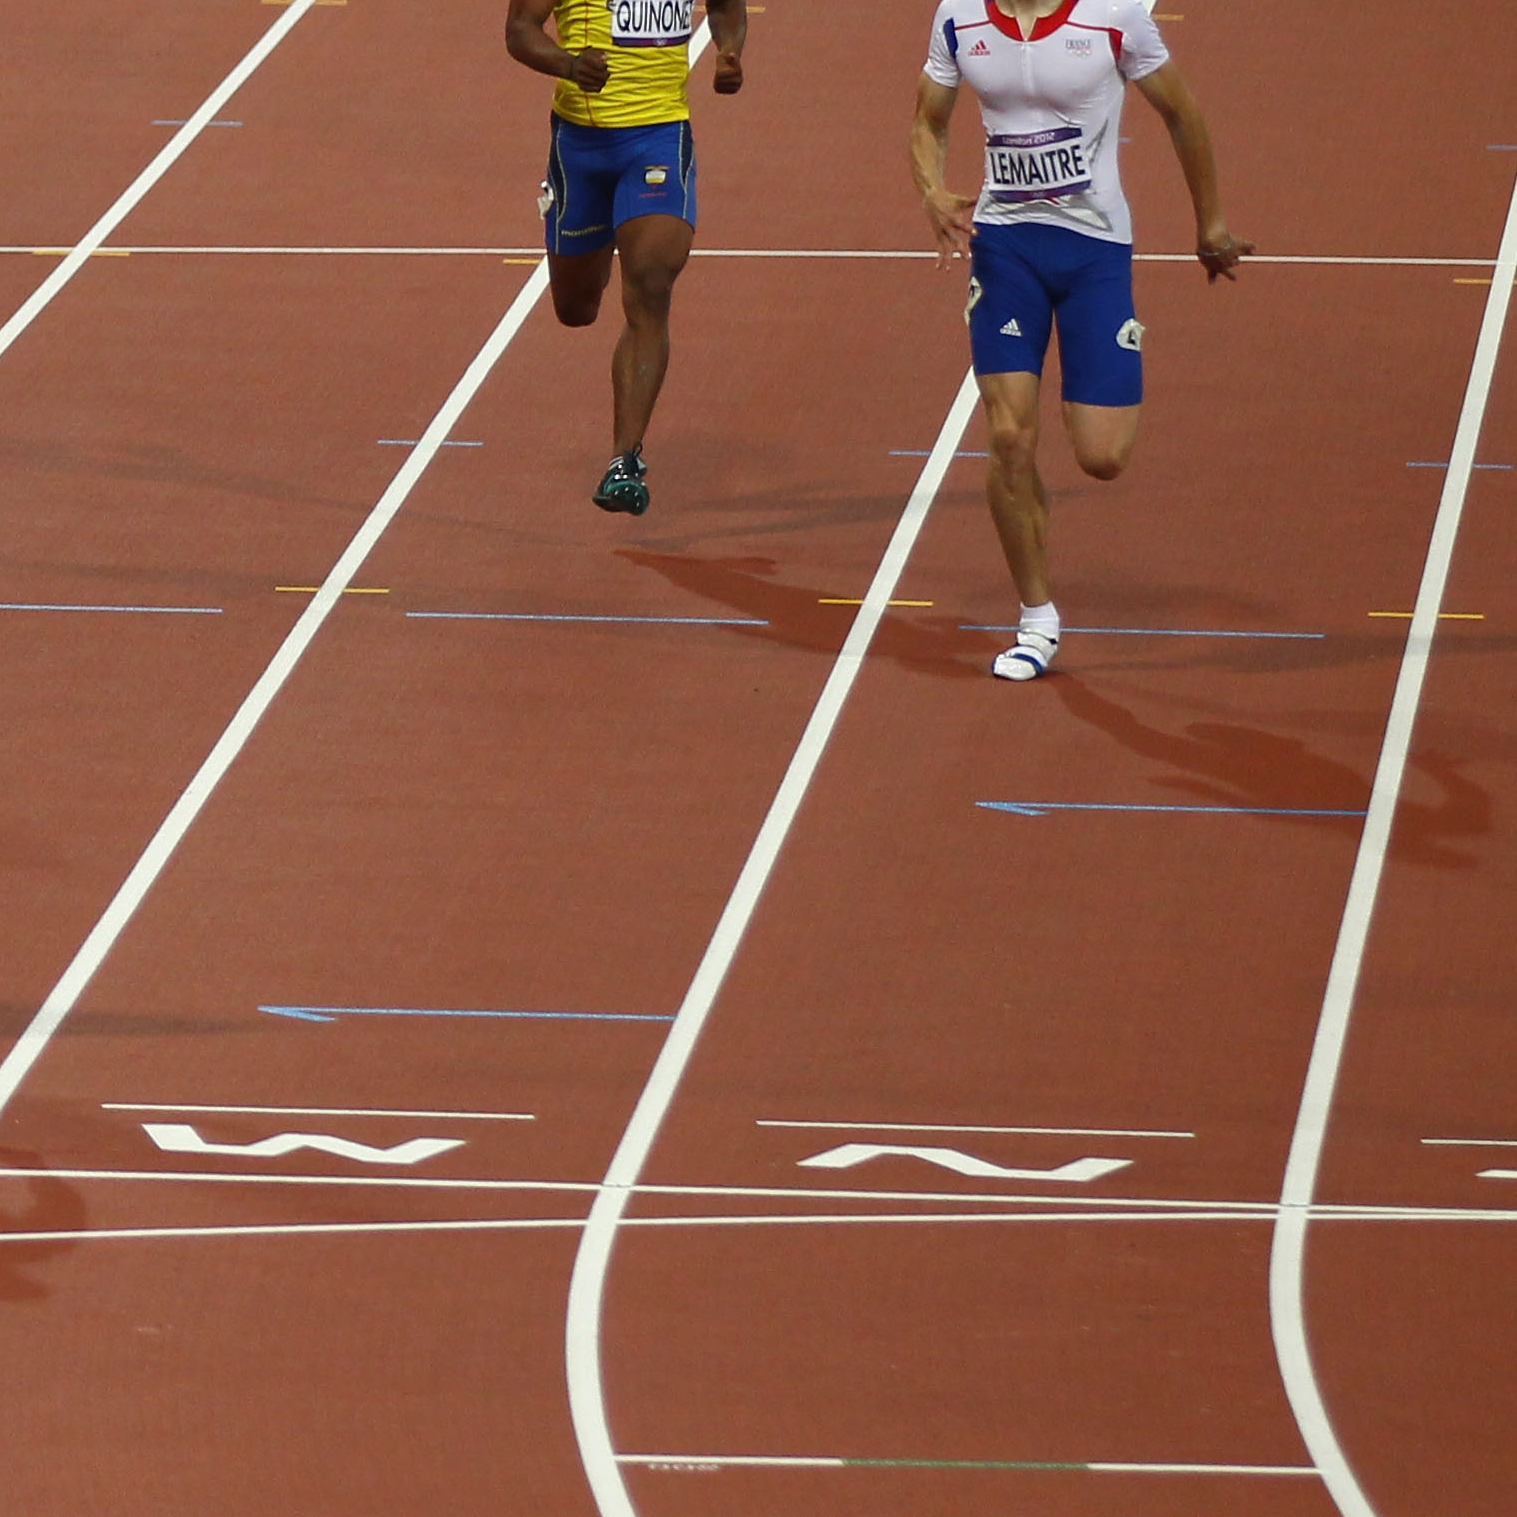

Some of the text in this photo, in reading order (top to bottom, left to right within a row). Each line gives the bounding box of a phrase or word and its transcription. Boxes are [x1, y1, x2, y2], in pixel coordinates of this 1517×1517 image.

[990, 144, 1086, 186] LEMAITRE
[141, 1122, 467, 1165] 3
[797, 1142, 1134, 1183] 2
